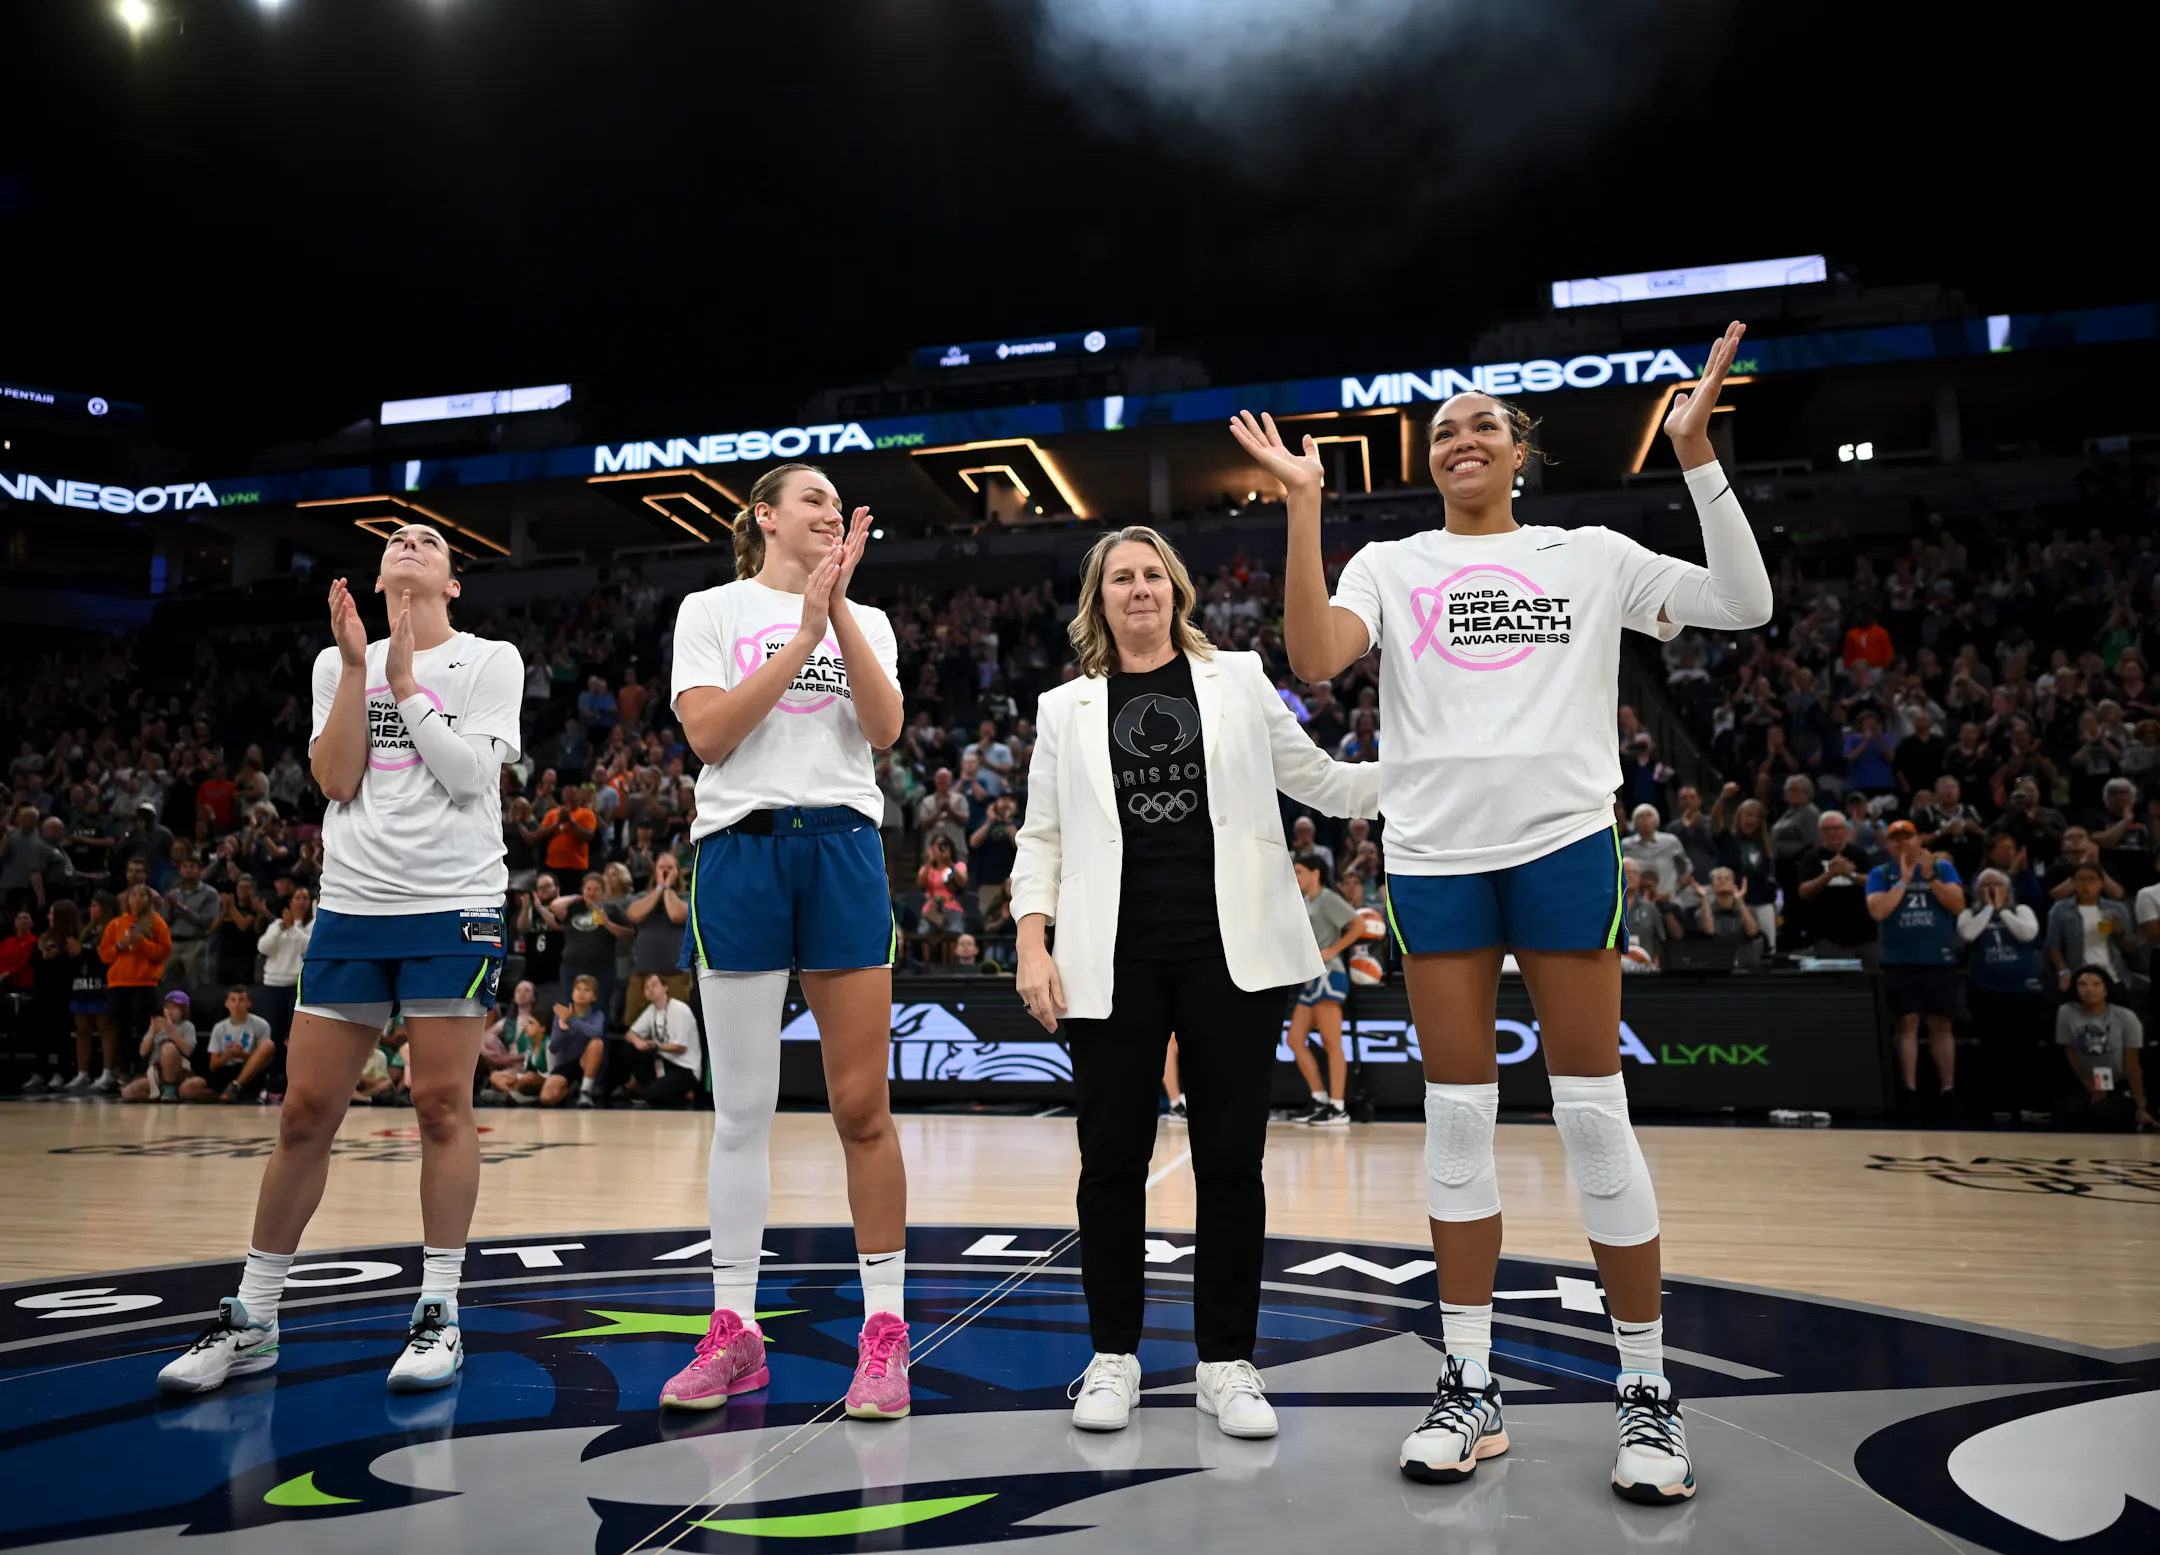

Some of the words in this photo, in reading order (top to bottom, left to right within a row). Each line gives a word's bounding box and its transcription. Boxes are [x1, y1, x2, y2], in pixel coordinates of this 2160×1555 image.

[1342, 348, 1693, 408] MINNESOTA
[4, 387, 55, 404] PENTAIR
[594, 422, 874, 473] MINNESOTA
[875, 432, 925, 449] LYNX
[220, 491, 260, 506] LYNX
[1449, 589, 1509, 601] WNBA
[1448, 598, 1570, 615] BREAST
[1449, 615, 1571, 633] HEALTH
[1450, 633, 1570, 646] AWARENESS
[1907, 892, 1928, 909] 21
[536, 934, 547, 952] 6
[1660, 1044, 1770, 1066] LYNX
